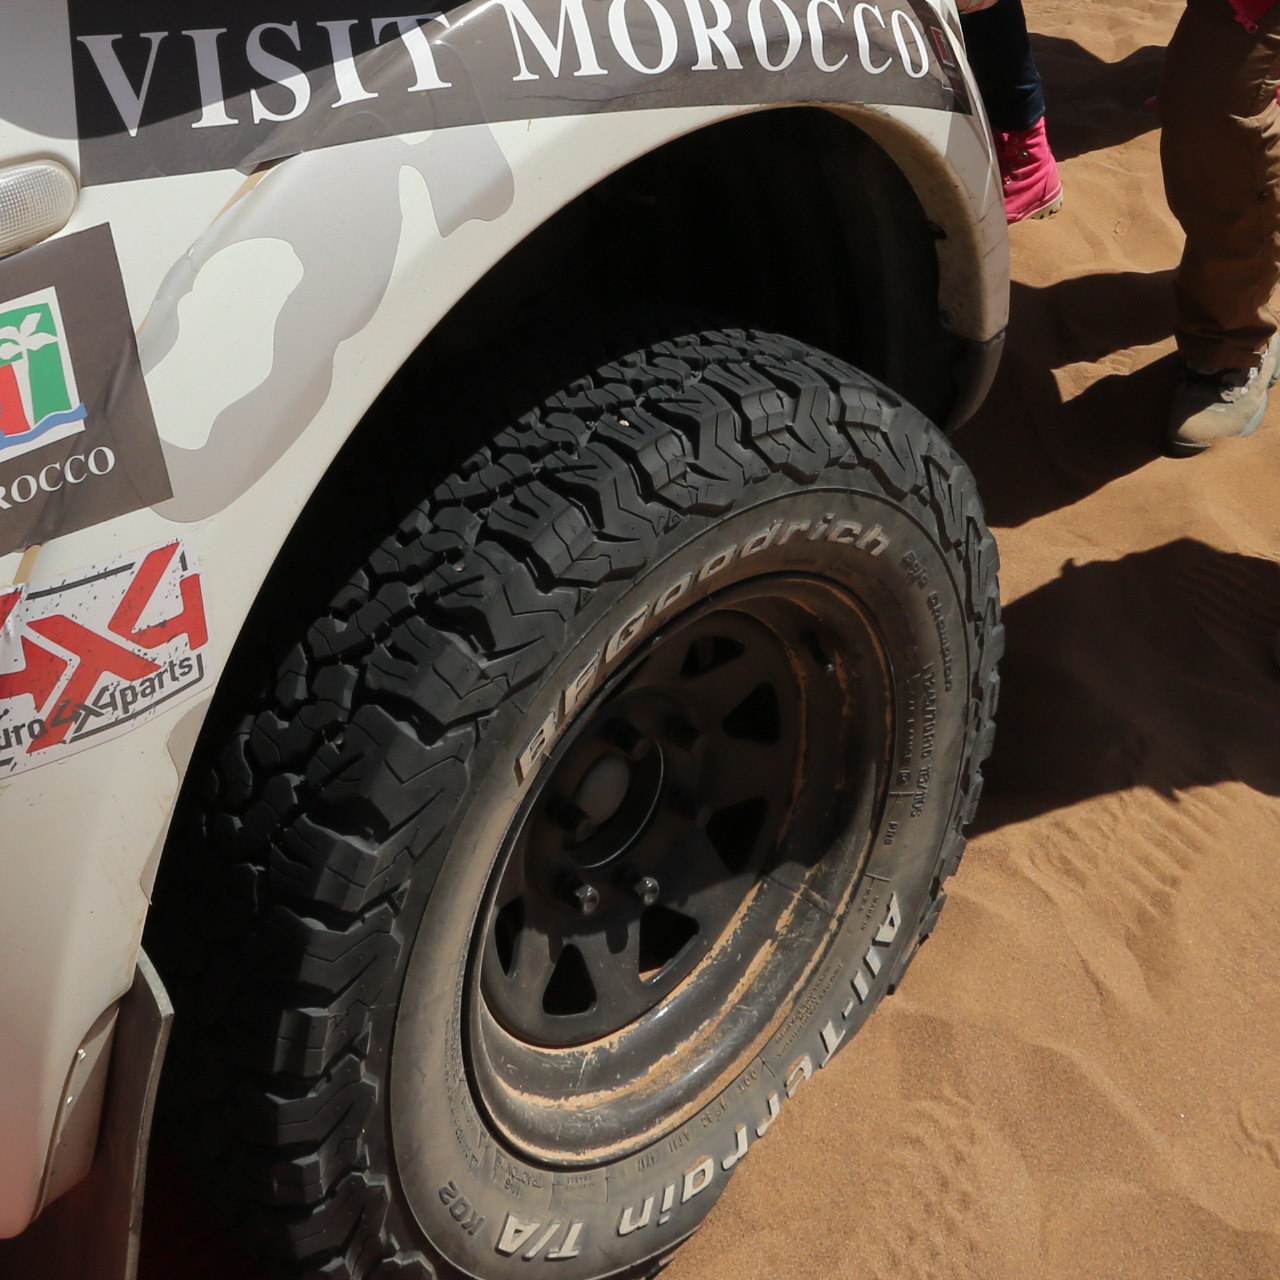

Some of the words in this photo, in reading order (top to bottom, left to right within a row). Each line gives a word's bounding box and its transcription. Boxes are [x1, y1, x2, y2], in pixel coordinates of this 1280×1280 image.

[77, 11, 452, 138] VISIT
[518, 513, 892, 787] BFGoodrich
[617, 891, 903, 1237] All-Terrain
[495, 1210, 584, 1262] T/A
